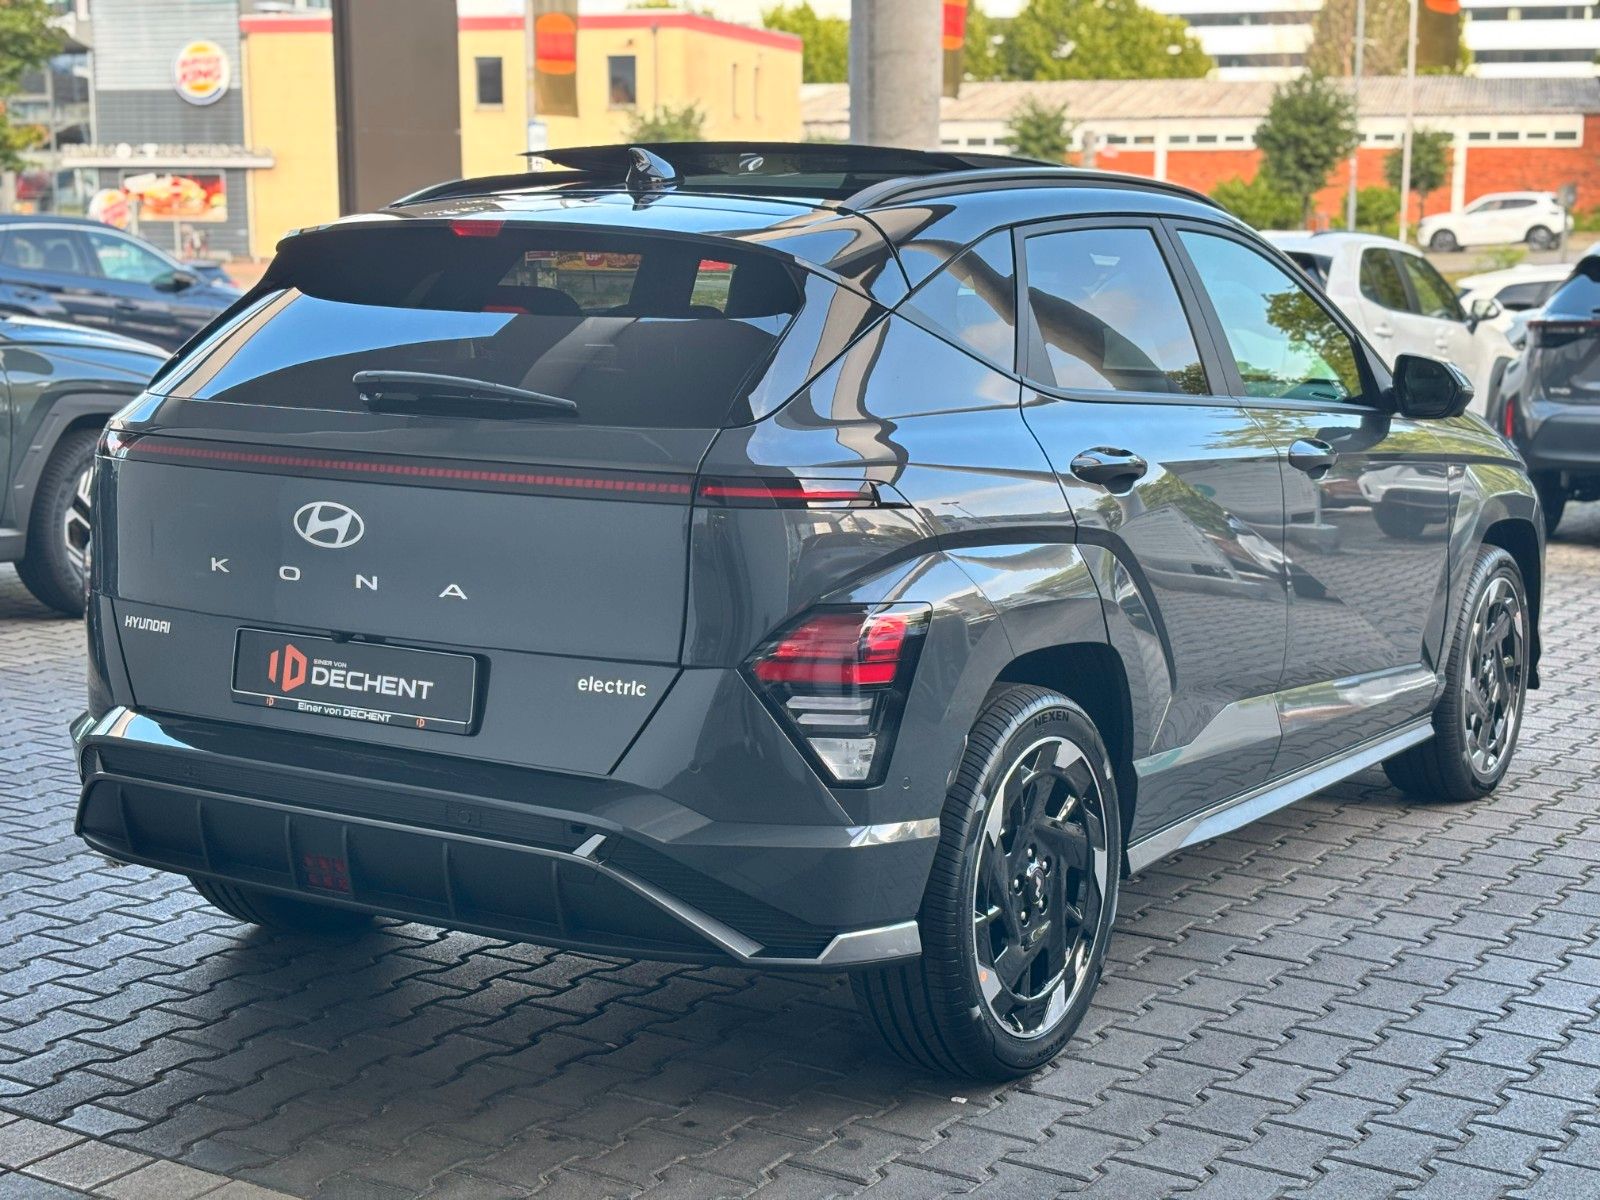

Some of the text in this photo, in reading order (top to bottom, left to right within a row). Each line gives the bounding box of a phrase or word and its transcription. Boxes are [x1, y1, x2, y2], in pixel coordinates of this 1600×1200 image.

[211, 556, 468, 600] KONA
[124, 615, 171, 634] HYUNDAI
[310, 667, 434, 700] DECHENT
[577, 675, 647, 697] electric
[297, 702, 392, 723] Einer von DECHENT
[1033, 710, 1070, 728] NEXEN
